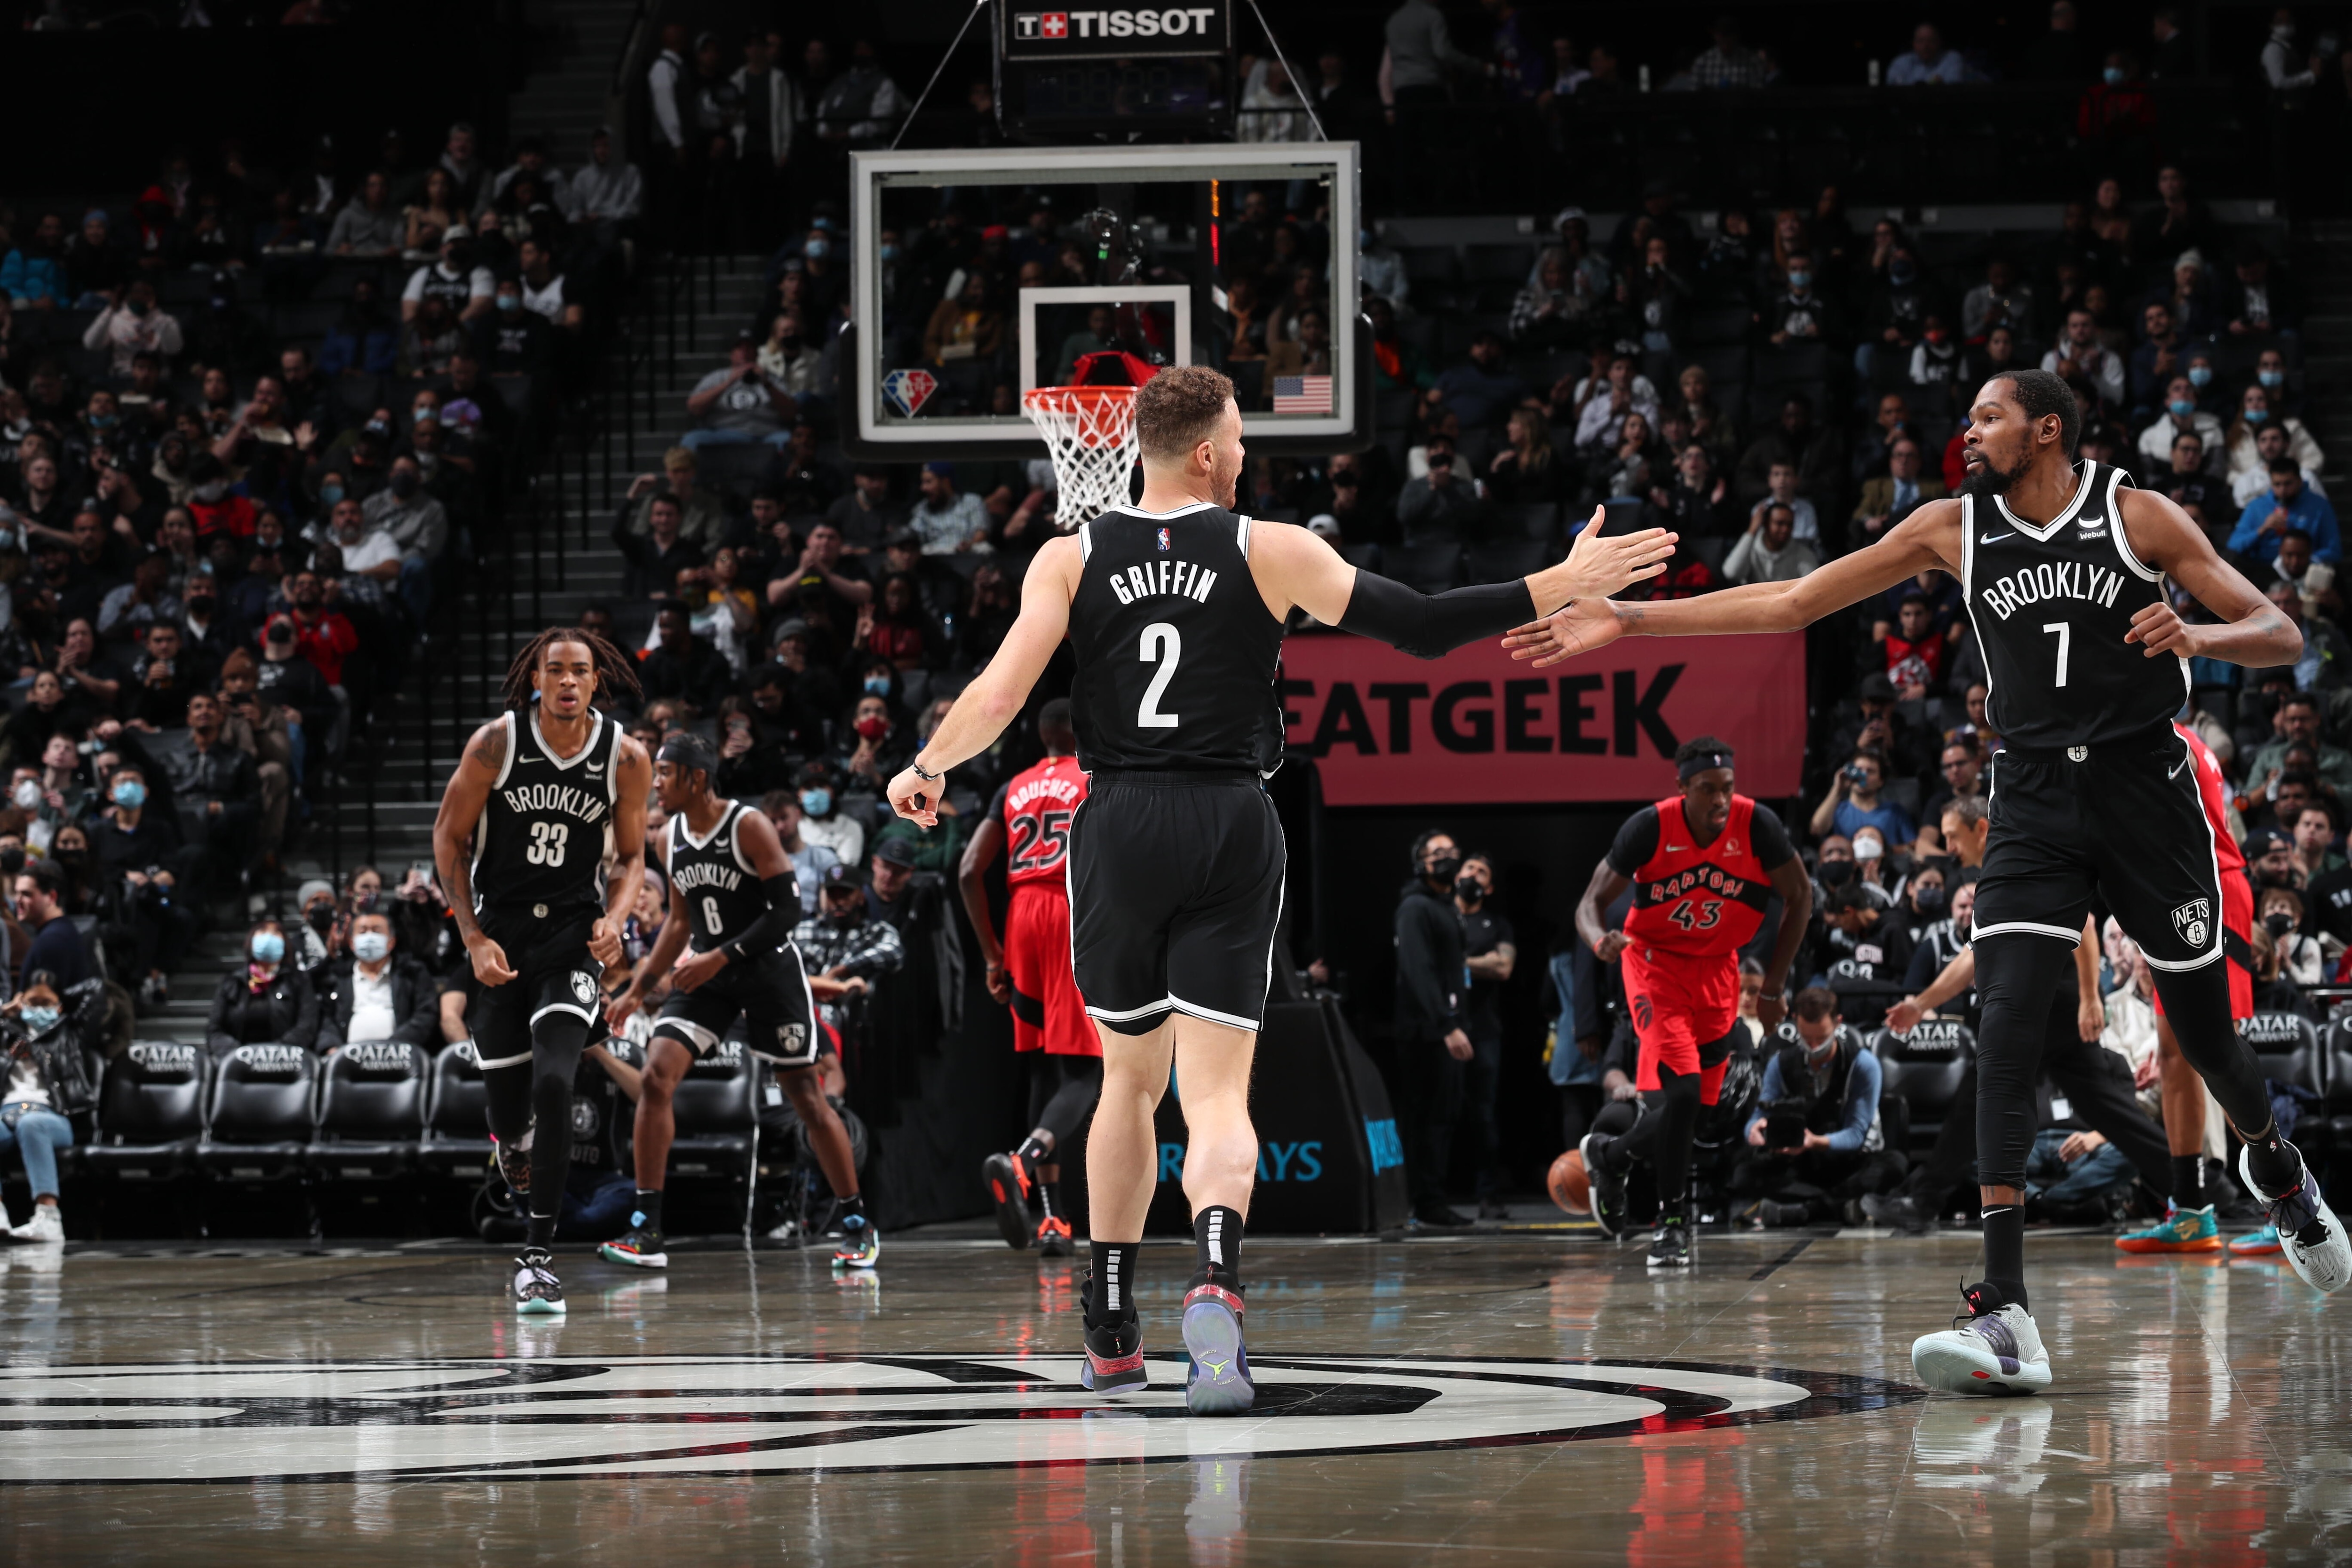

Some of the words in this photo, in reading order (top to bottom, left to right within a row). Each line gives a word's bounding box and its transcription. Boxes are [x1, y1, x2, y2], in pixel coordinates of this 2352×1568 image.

[1070, 8, 1215, 38] TISSOT
[2080, 530, 2106, 540] Webull
[1109, 560, 1217, 605] GRIFFIN
[1982, 562, 2125, 621] BROOKLYN
[2043, 622, 2069, 687] 7
[1138, 622, 1181, 727] 2
[1283, 662, 1688, 760] EATGEEK
[504, 783, 606, 823] BROOKLYN
[1009, 778, 1079, 812] BOUCHER
[526, 821, 569, 868] 33
[1009, 809, 1073, 874] 25
[702, 896, 723, 935] 6
[1668, 899, 1724, 931] 43
[2175, 900, 2209, 928] NETS
[573, 971, 596, 995] NETS
[128, 1045, 197, 1065] QATAR
[236, 1045, 304, 1065] QATAR
[344, 1043, 412, 1063] QATAR
[1907, 1038, 1959, 1051] AIRWAYS
